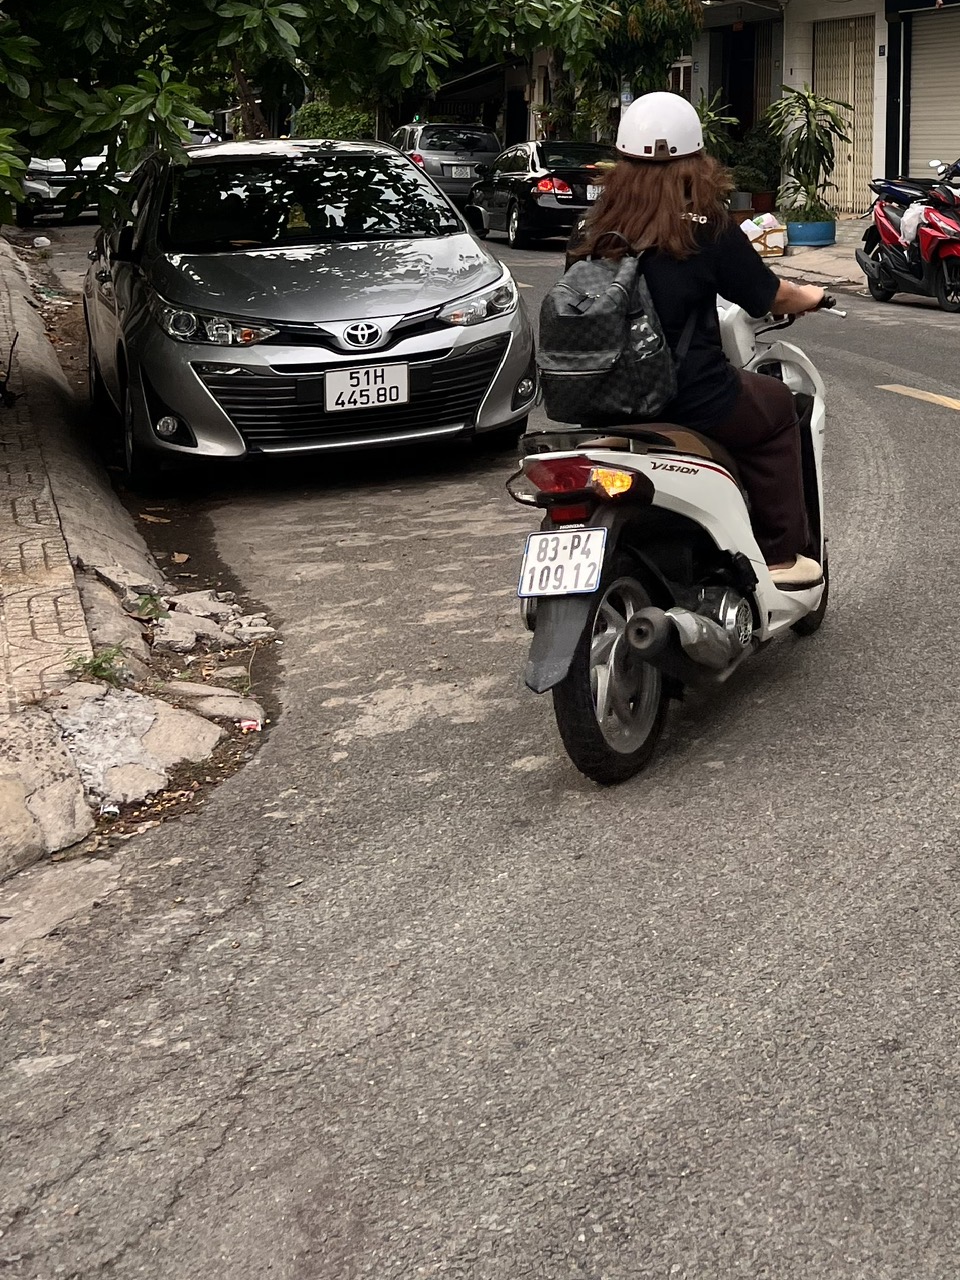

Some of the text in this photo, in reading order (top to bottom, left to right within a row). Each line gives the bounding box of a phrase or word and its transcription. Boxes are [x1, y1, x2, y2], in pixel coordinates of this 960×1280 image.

[349, 368, 385, 387] 51H
[335, 385, 399, 408] 445.80
[650, 461, 700, 476] VISION
[536, 533, 592, 563] 83-P4
[528, 562, 597, 593] 109.12
